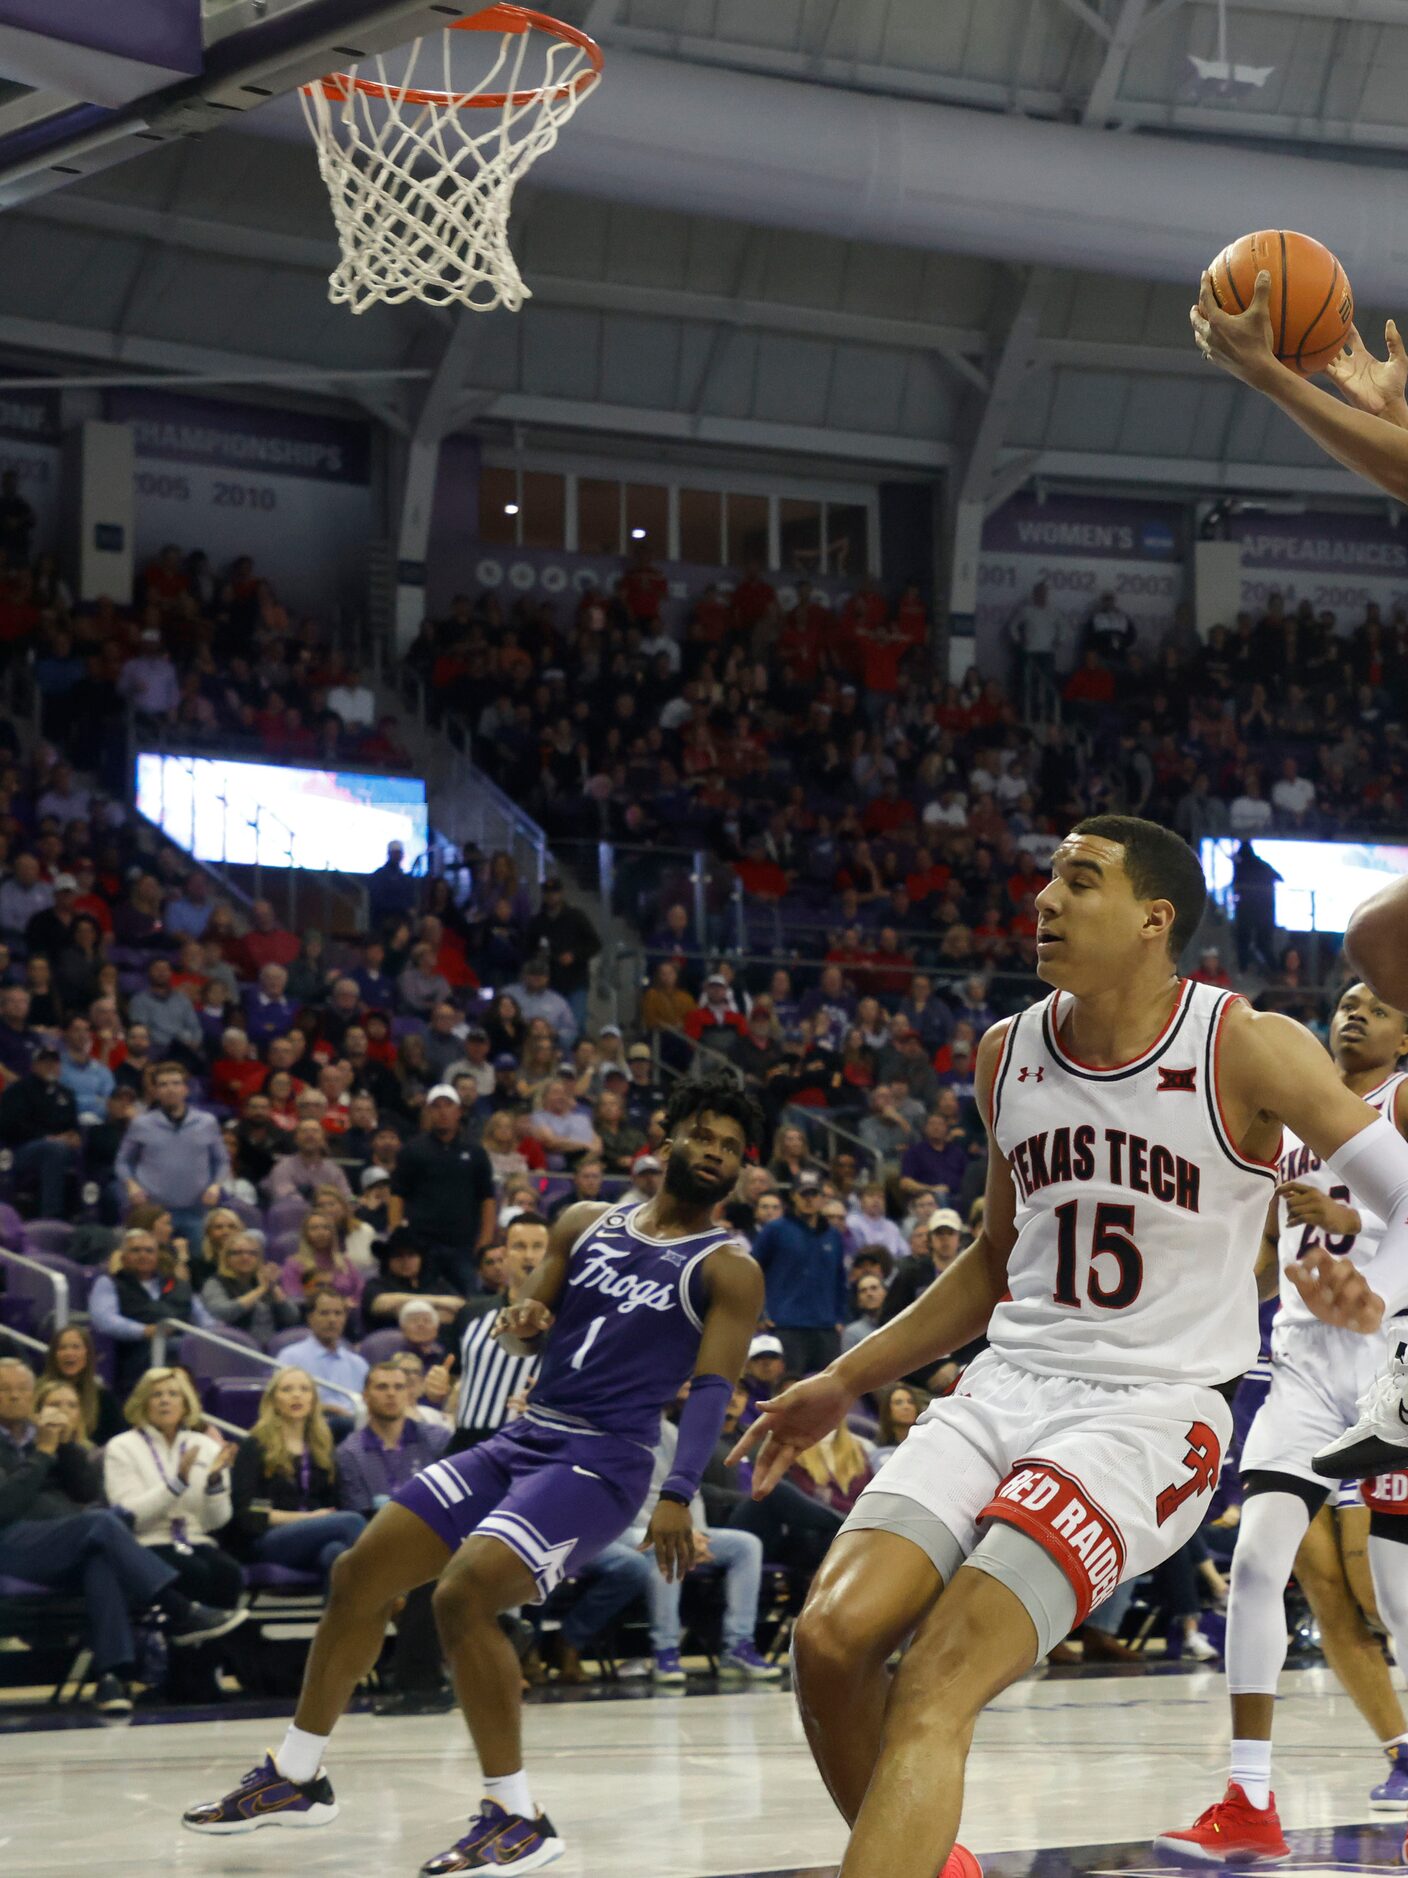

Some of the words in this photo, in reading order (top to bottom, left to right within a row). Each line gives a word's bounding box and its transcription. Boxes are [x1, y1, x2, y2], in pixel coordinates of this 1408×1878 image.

[134, 421, 343, 471] HAMPIONSHIPS
[133, 472, 190, 501] 005
[213, 481, 277, 512] 2010
[1016, 521, 1134, 549] WOMEN'S
[1241, 534, 1408, 567] APPEARANCES
[978, 564, 1016, 587] 001
[1105, 1128, 1200, 1213] TECH
[1278, 1144, 1322, 1184] EXAS
[569, 1242, 676, 1313] Frogs
[1053, 1199, 1143, 1309] 15
[570, 1316, 607, 1370] 1
[998, 1469, 1060, 1511] RED
[1050, 1497, 1119, 1613] RAIDER
